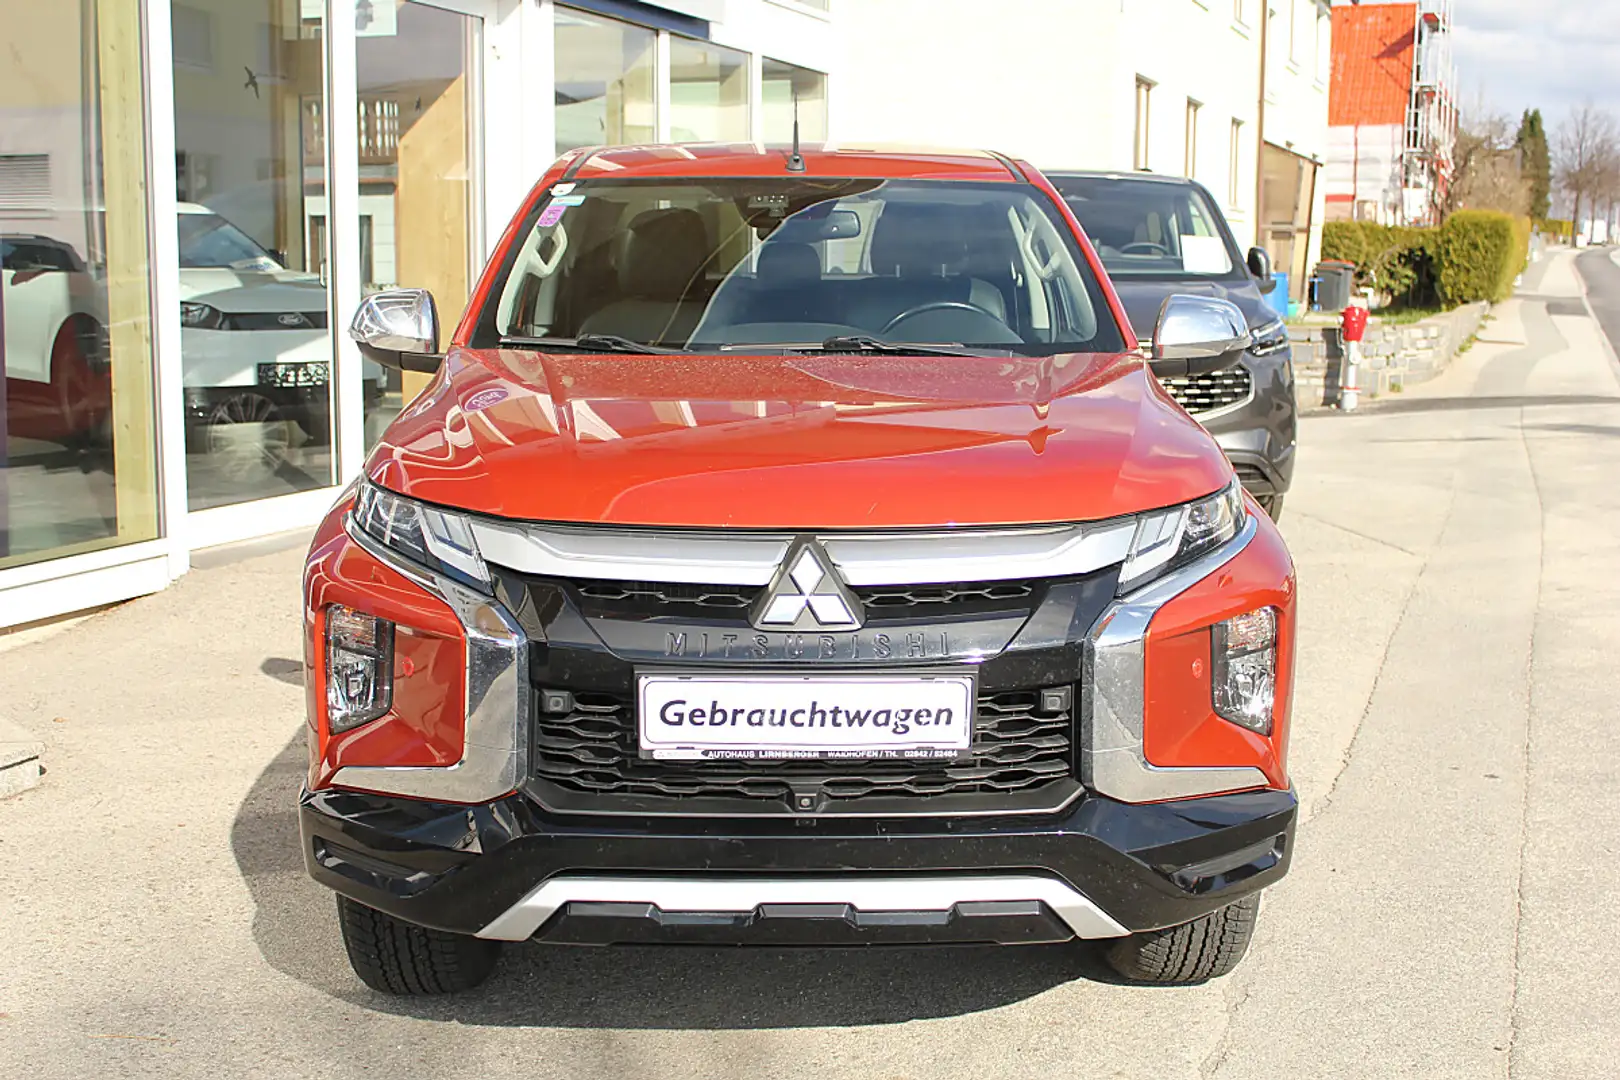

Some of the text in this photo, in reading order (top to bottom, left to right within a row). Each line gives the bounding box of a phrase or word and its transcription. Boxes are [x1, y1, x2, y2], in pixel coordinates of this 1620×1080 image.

[665, 632, 951, 659] MITSUBISHI
[659, 700, 953, 734] Gebrauchtwagen
[707, 750, 755, 759] AUTOHAUS
